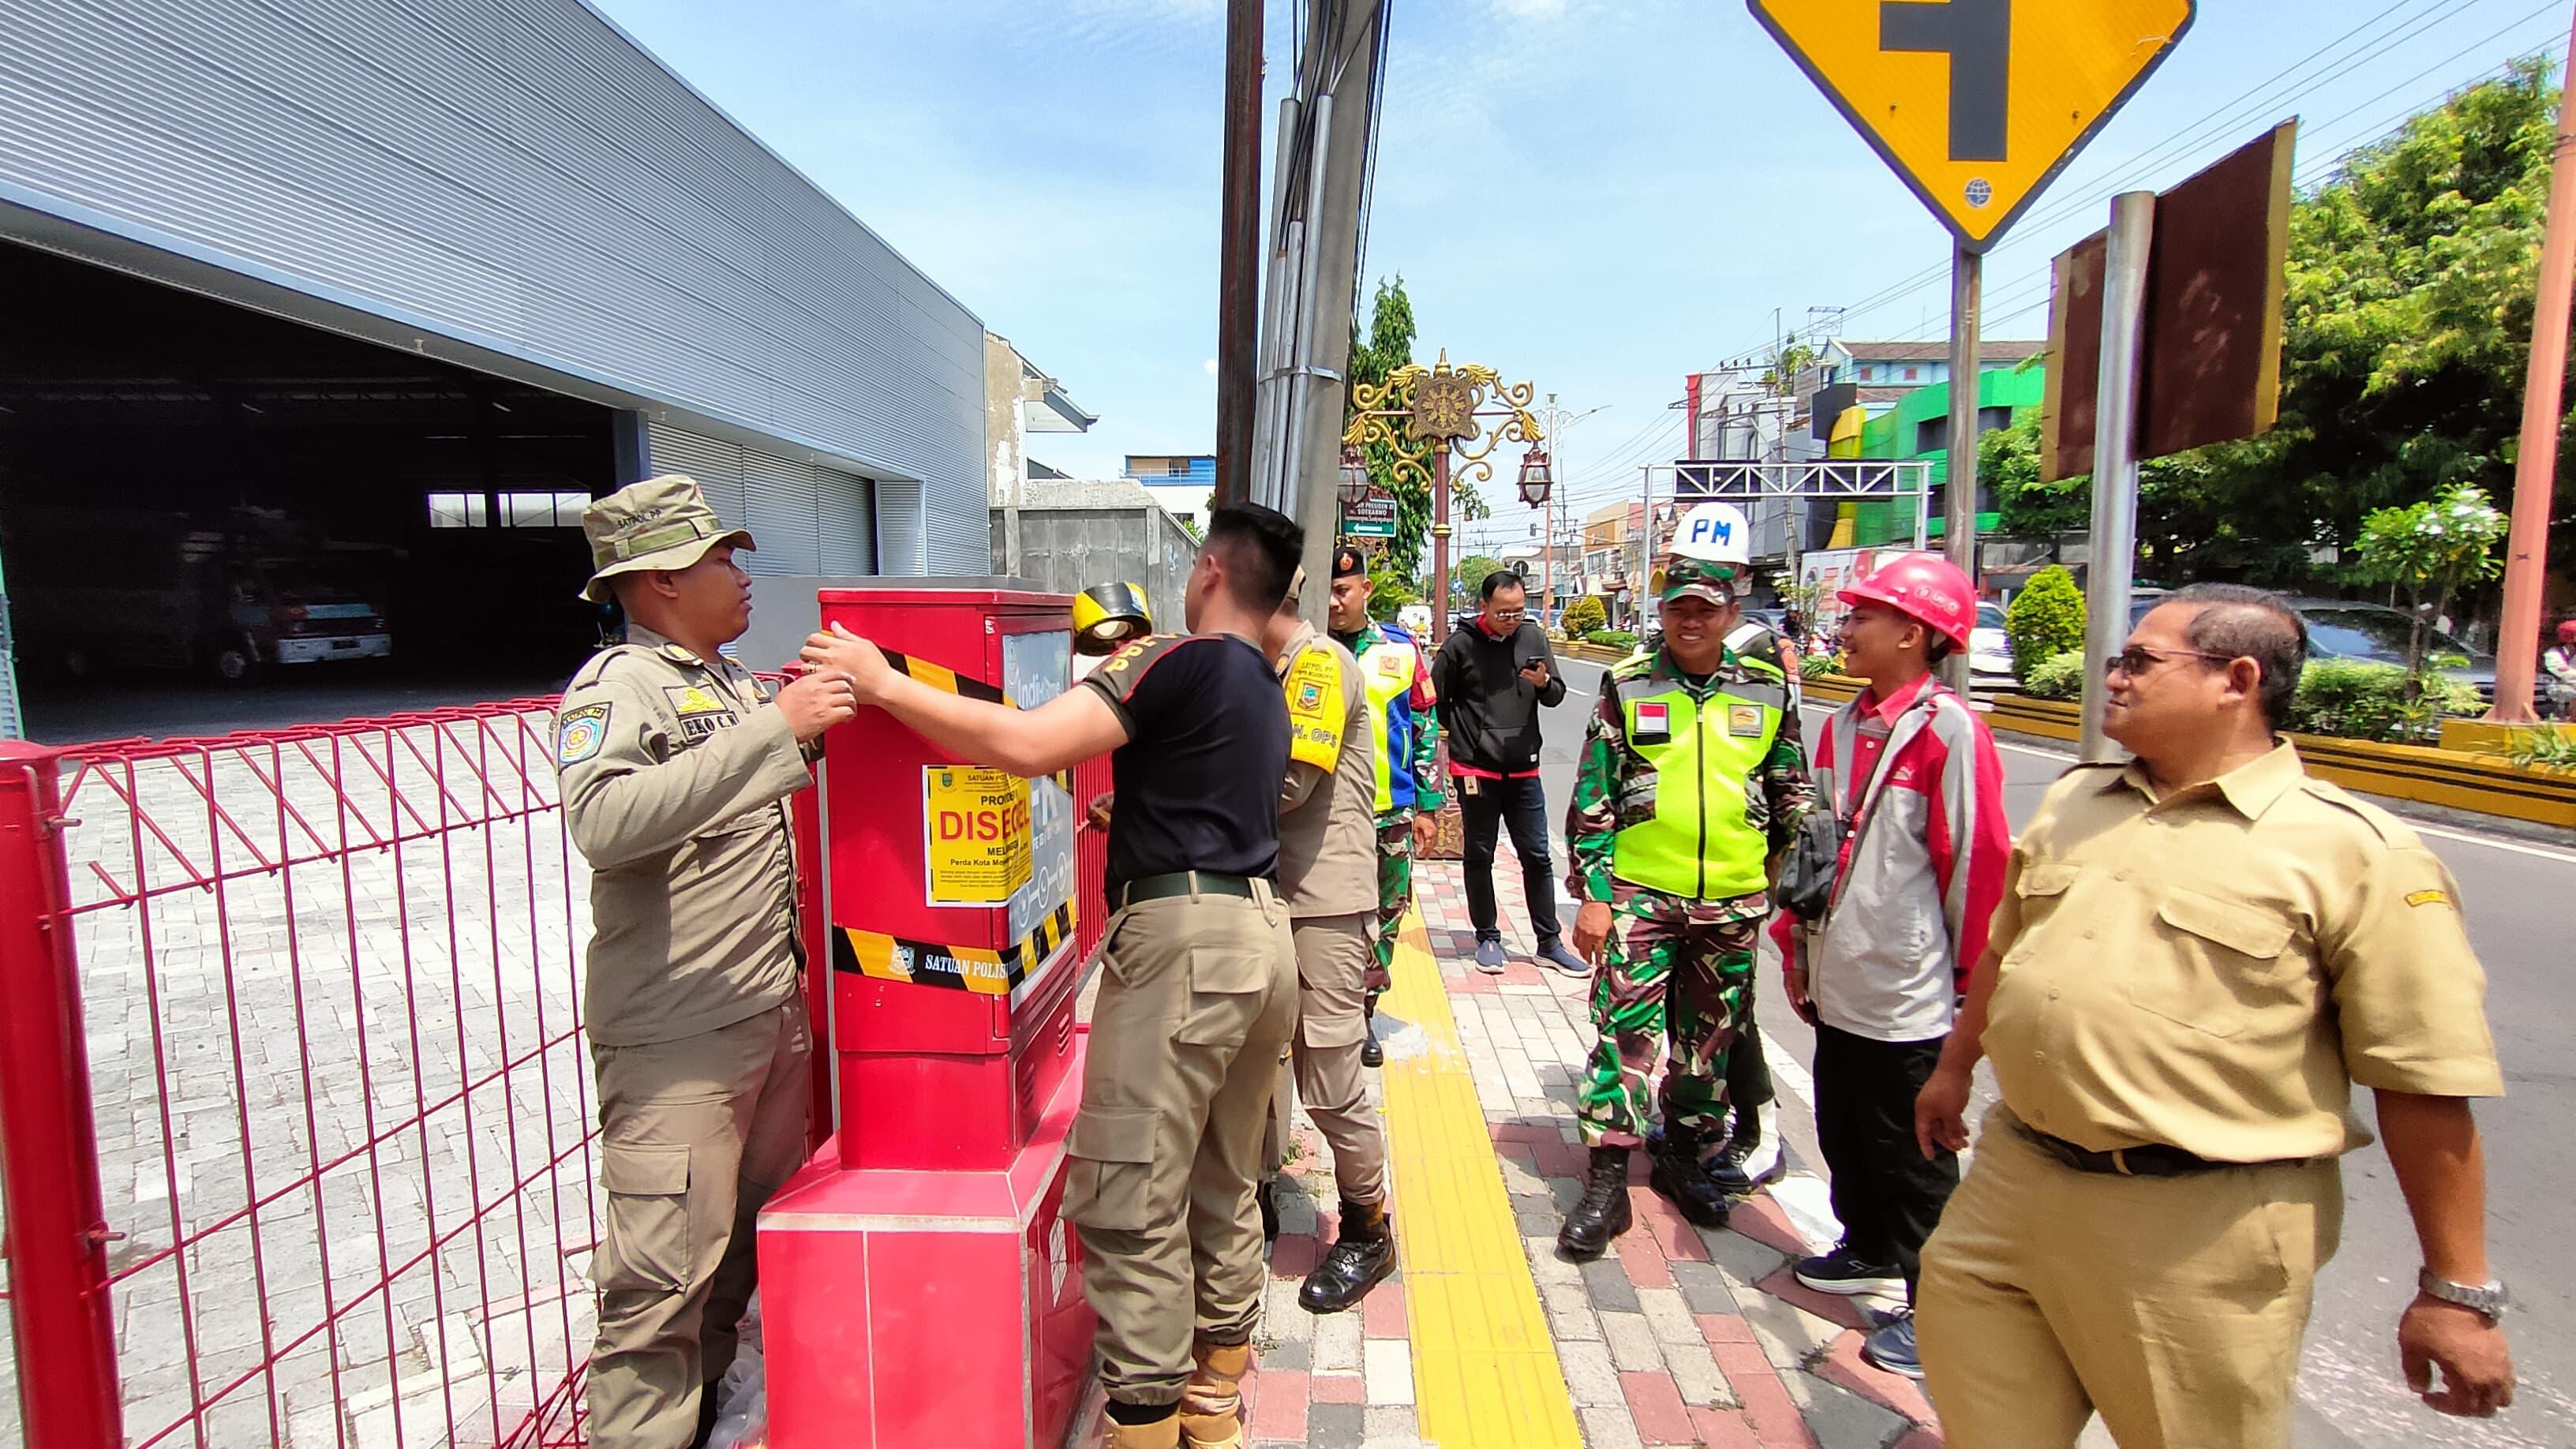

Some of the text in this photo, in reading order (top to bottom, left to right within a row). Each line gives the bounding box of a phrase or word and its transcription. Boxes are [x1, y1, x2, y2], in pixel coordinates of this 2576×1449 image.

[617, 509, 661, 528] SATPOL PP
[1691, 519, 1732, 546] PM
[683, 717, 714, 736] EKO
[1311, 728, 1338, 748] OPS
[925, 954, 971, 975] SATUAN
